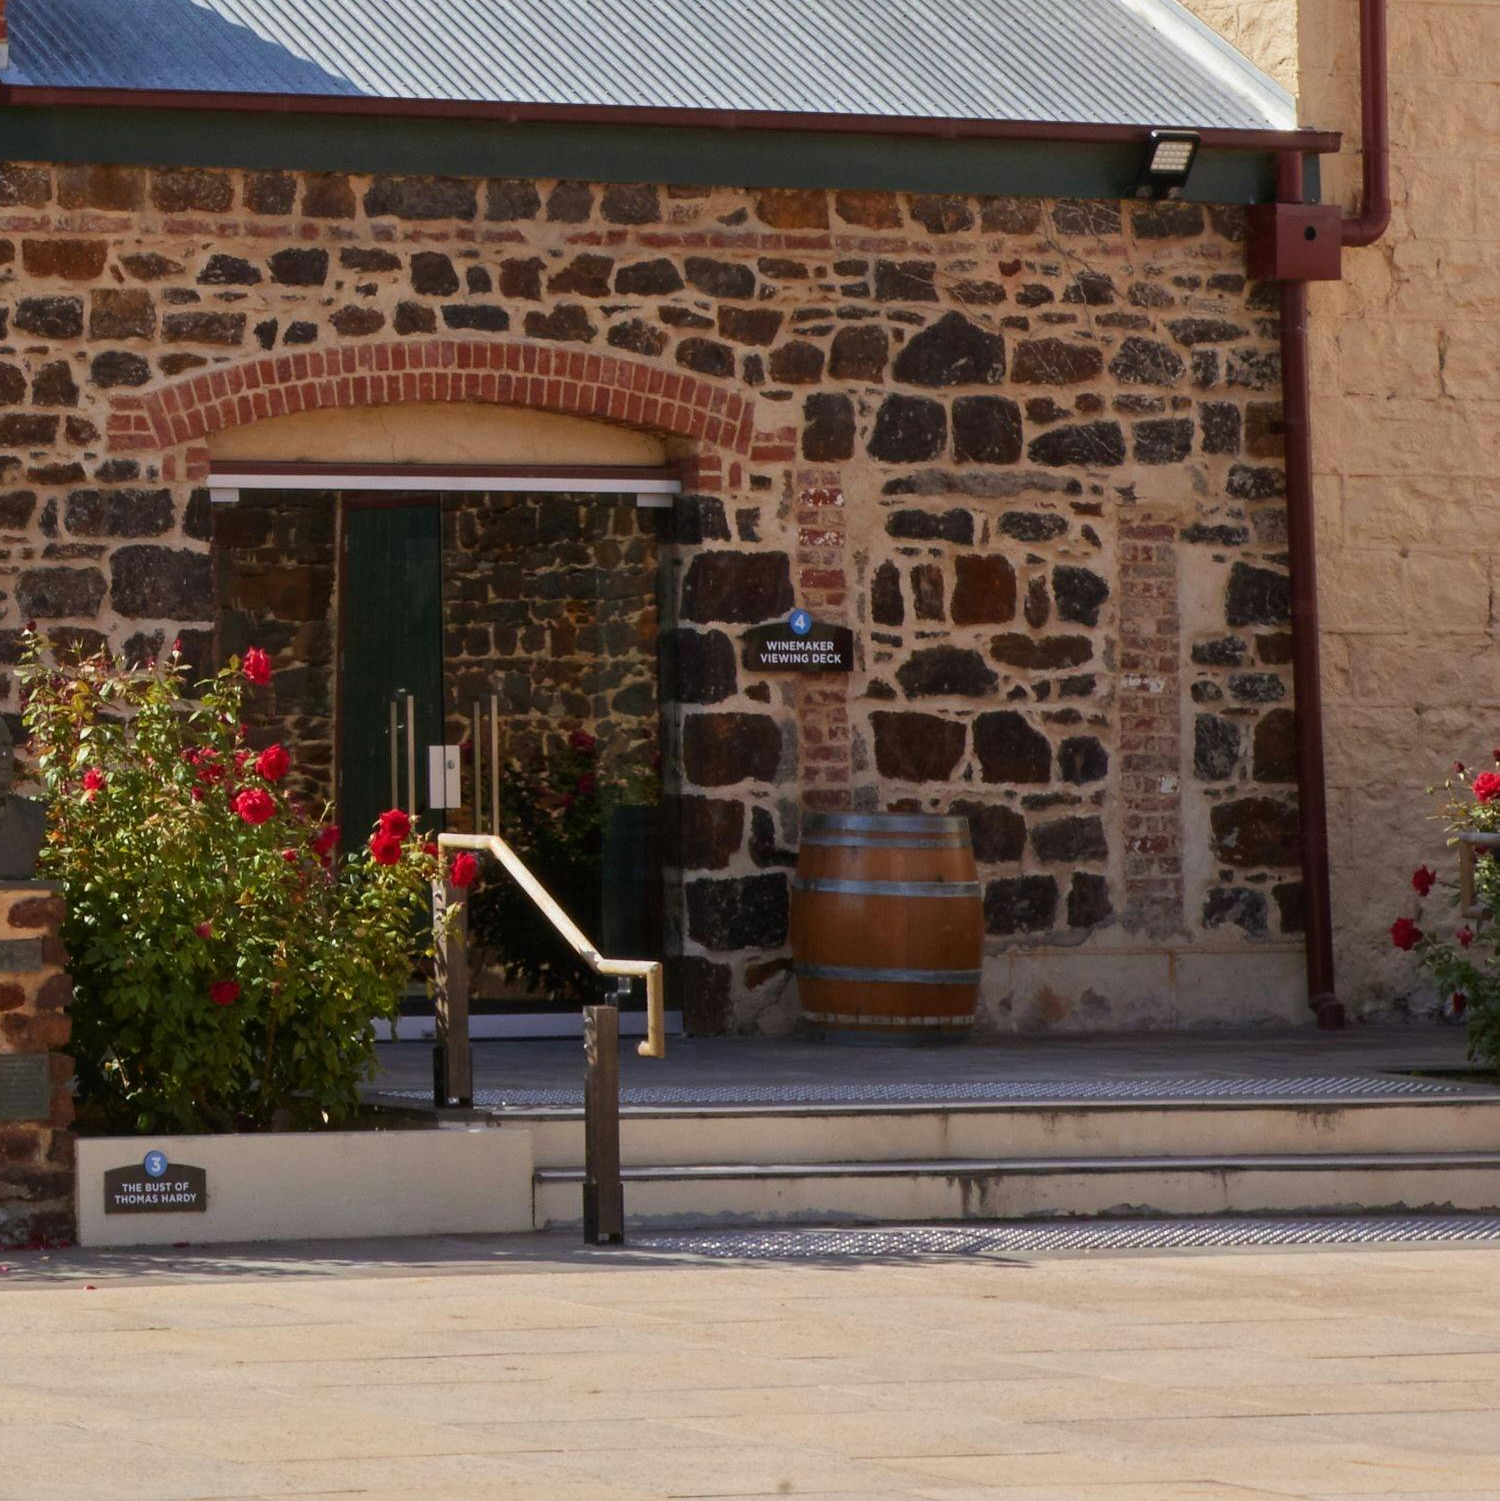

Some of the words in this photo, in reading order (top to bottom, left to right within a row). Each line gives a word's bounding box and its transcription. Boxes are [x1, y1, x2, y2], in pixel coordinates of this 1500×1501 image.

[794, 614, 806, 629] 4
[766, 641, 834, 651] WINEMAKER
[760, 653, 809, 664] VIEWING
[812, 653, 842, 664] DECK
[151, 1157, 162, 1172] 3
[122, 1183, 142, 1192] THE
[145, 1182, 171, 1192] BUST
[174, 1182, 189, 1191] OF
[115, 1194, 158, 1204] THOMAS
[161, 1193, 197, 1203] HARDY
